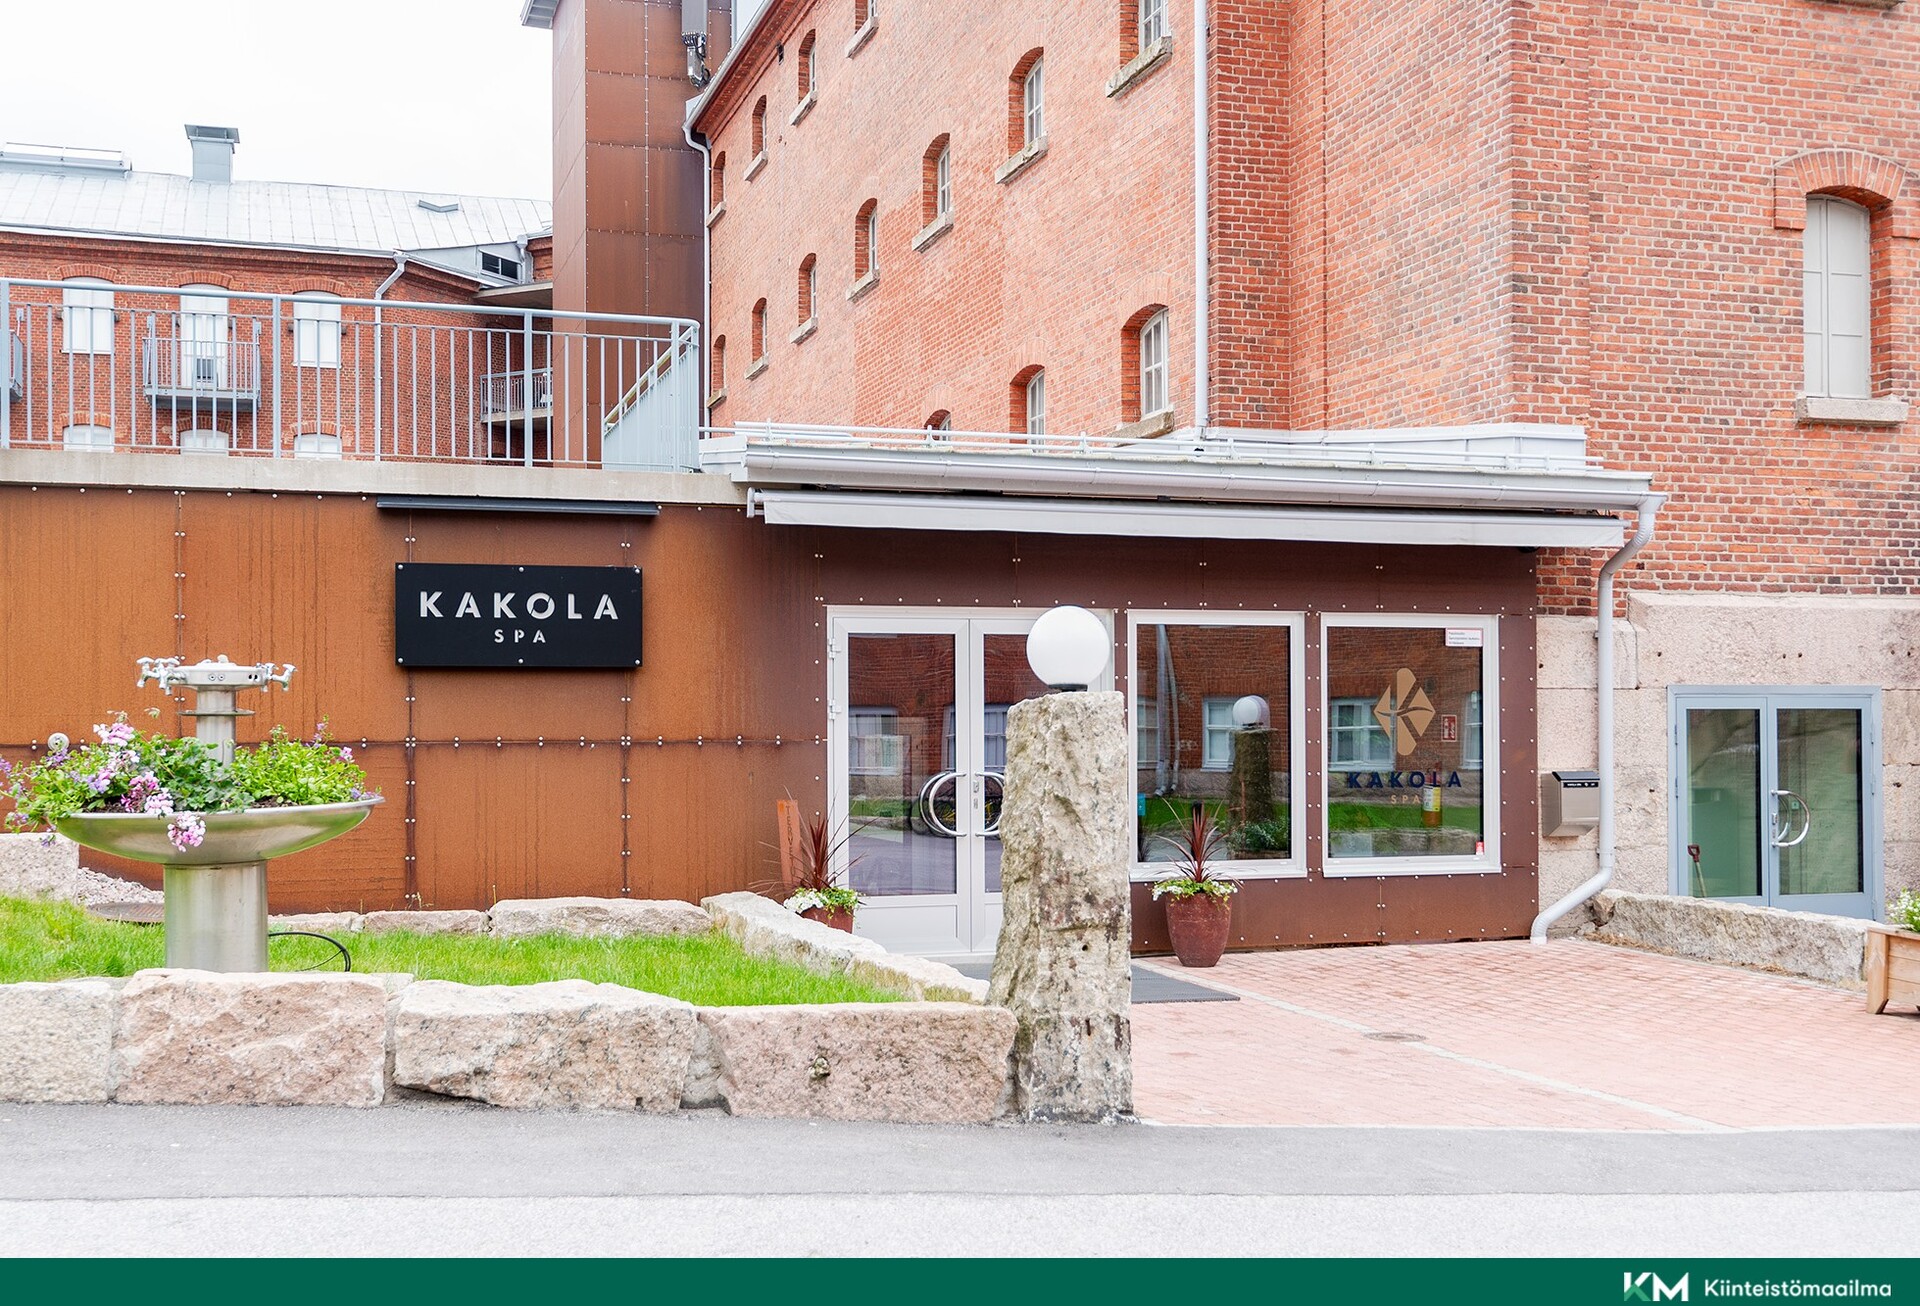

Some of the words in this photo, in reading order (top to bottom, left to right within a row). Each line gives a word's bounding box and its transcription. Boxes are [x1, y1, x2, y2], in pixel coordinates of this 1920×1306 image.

[419, 591, 619, 620] KAKOLA
[494, 629, 547, 644] SPA
[1347, 771, 1462, 788] KAKOLA
[1391, 795, 1421, 804] SPA
